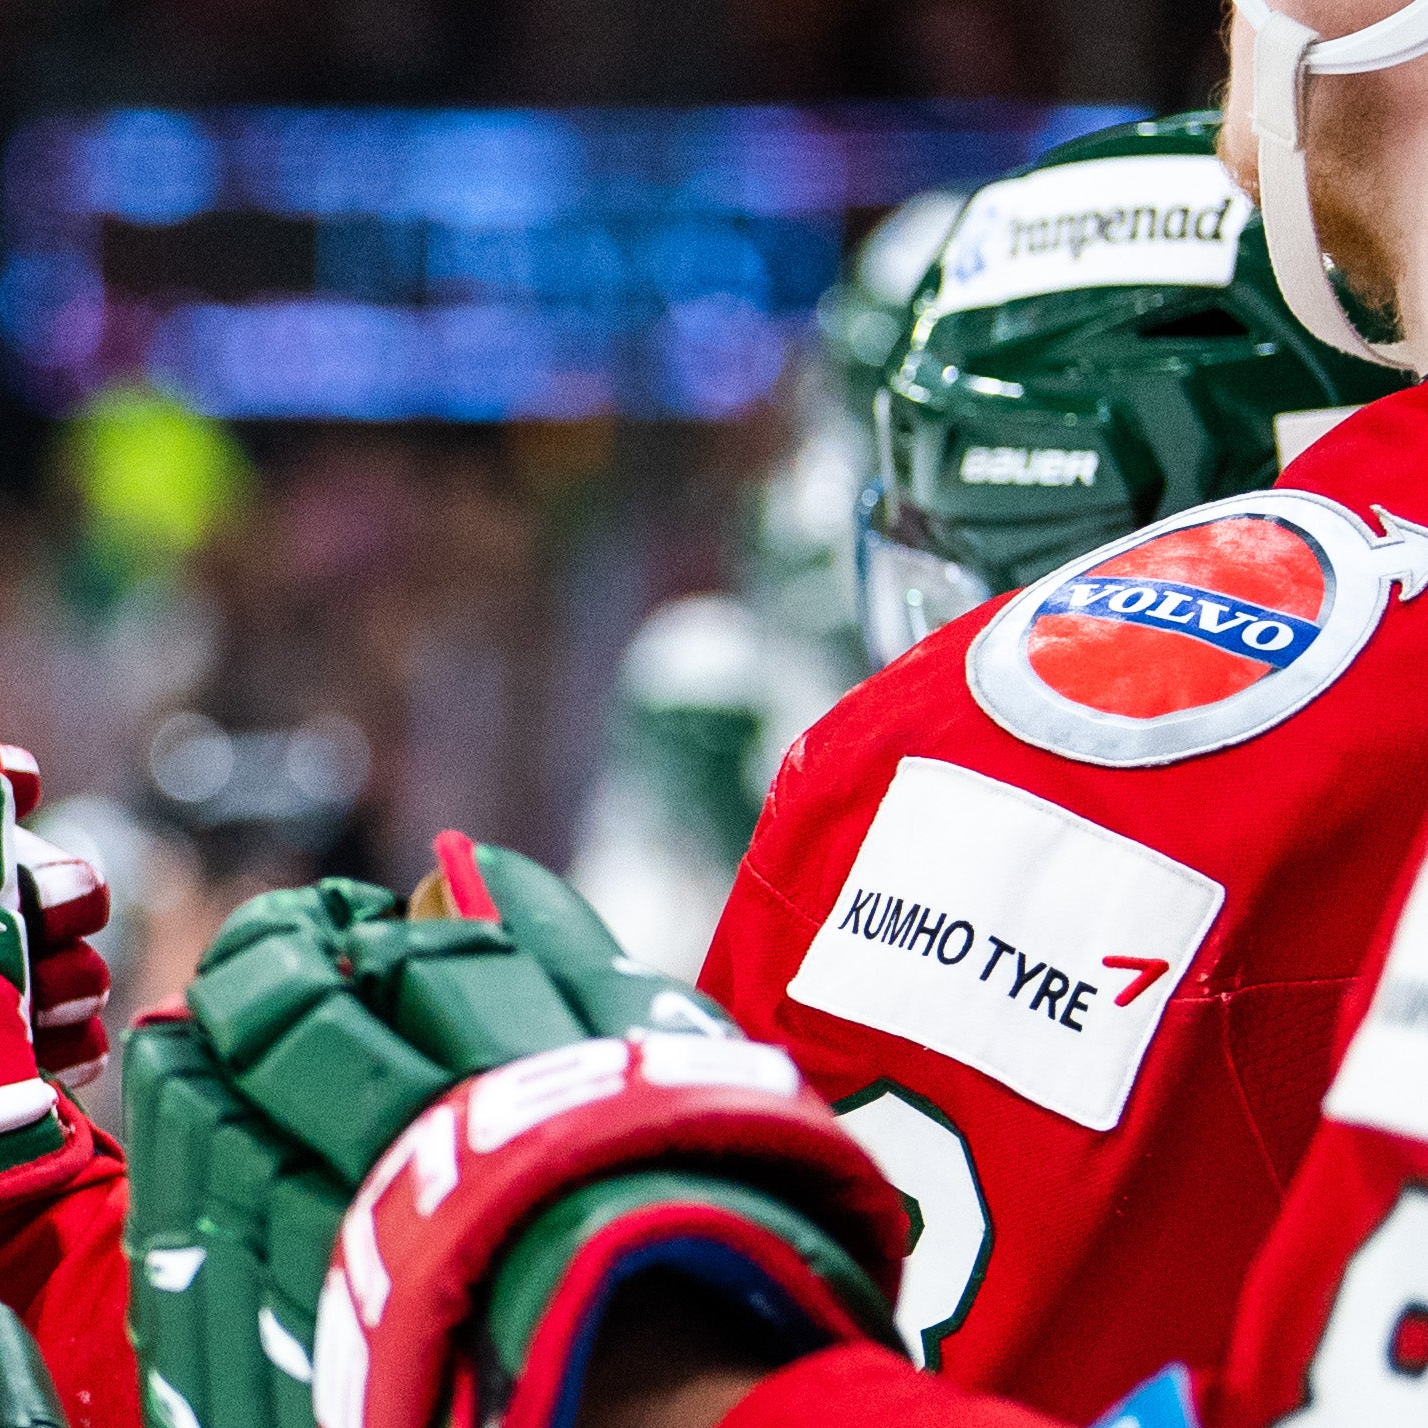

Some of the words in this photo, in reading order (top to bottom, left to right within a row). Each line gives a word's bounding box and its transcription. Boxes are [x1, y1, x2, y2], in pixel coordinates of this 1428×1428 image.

[1065, 581, 1296, 654] VOLVO
[837, 887, 977, 968] KUMHO
[979, 934, 1099, 1034] TYRE
